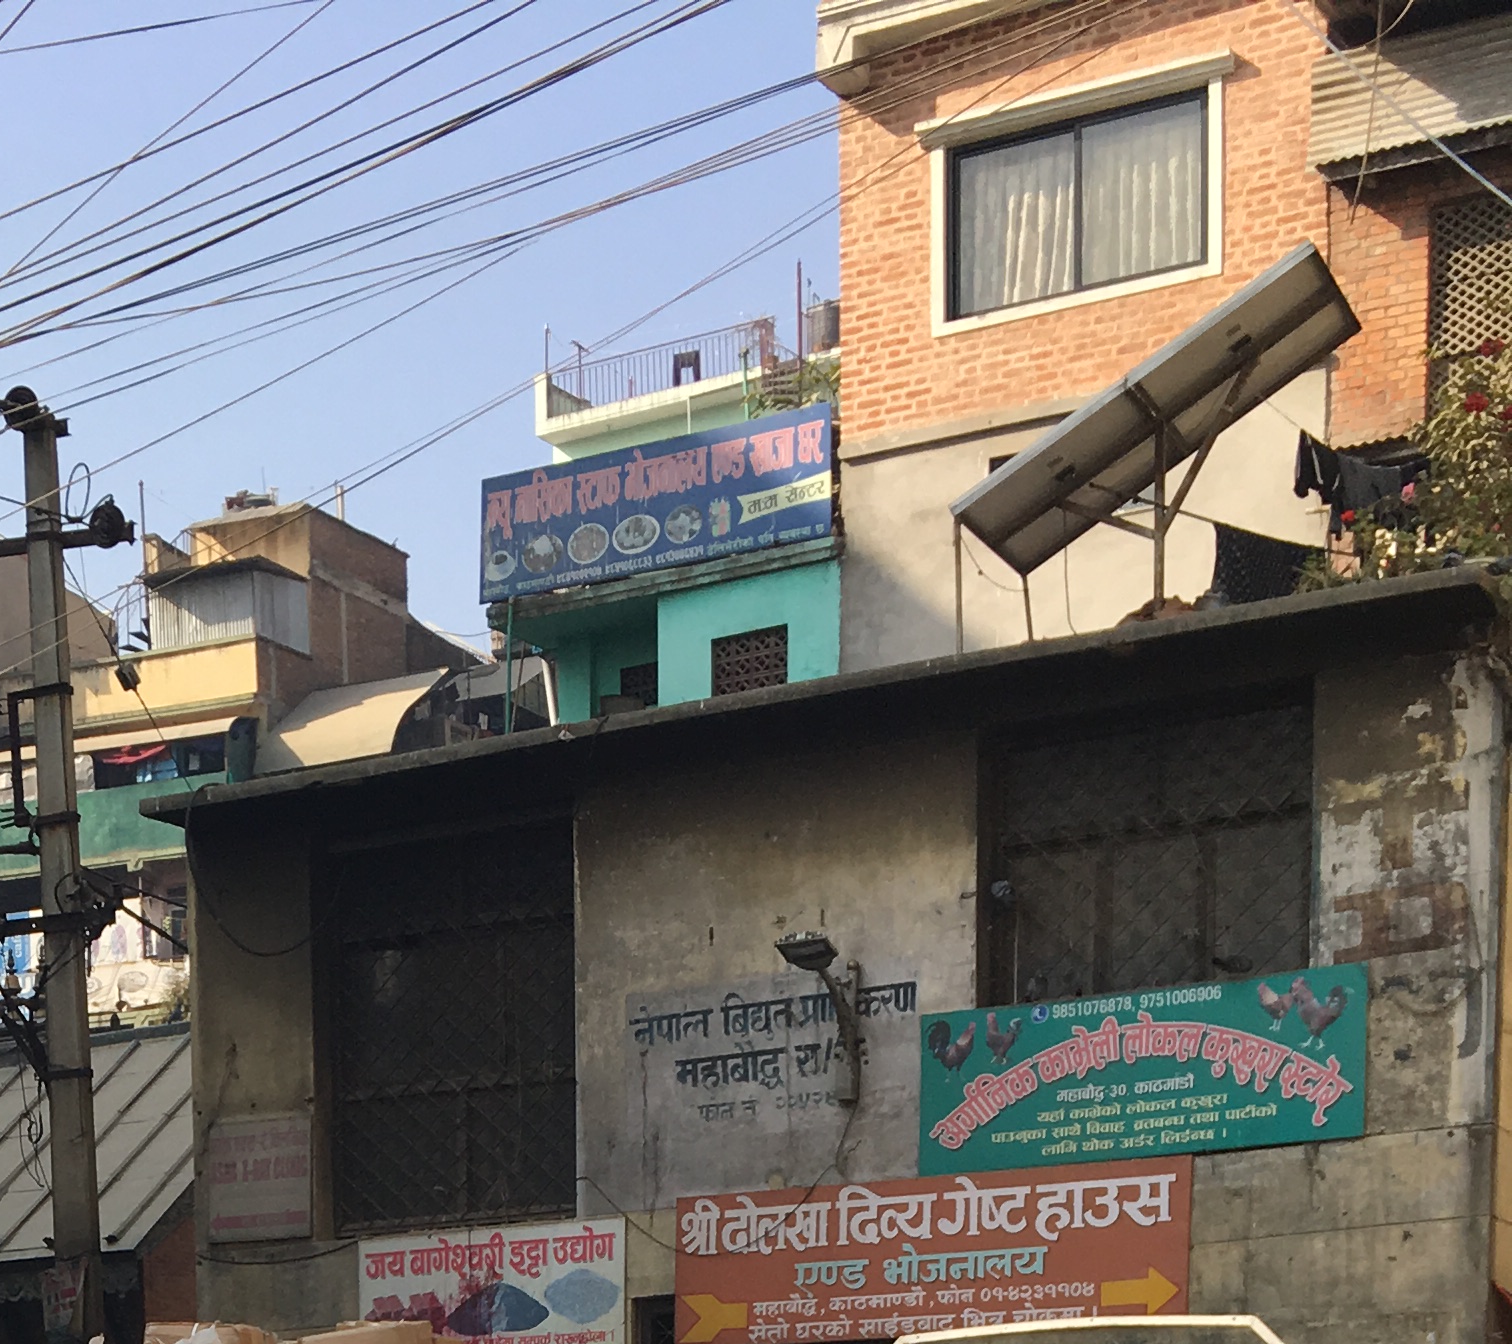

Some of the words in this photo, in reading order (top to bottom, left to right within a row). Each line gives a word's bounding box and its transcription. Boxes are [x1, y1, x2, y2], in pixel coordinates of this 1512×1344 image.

[1139, 985, 1222, 1010] 9751006906
[629, 1005, 714, 1046] नेपाल
[1121, 1010, 1207, 1064] लोकल
[1201, 1024, 1292, 1093] कुखुरा
[1279, 1053, 1355, 1127] स्टोर
[1125, 1097, 1178, 1115] लोकल
[681, 1195, 721, 1256] श्री
[720, 1194, 833, 1256] दोलखा
[836, 1184, 939, 1247] दिव्य
[937, 1175, 1032, 1237] गेष्ट
[1034, 1172, 1178, 1241] हाउस
[364, 1250, 406, 1281] जय
[552, 1224, 617, 1265] उद्योग
[793, 1258, 871, 1291] एण्ड
[882, 1243, 1049, 1286] भोजनालय
[748, 1318, 791, 1344] सेतो
[795, 1313, 854, 1338] घरको
